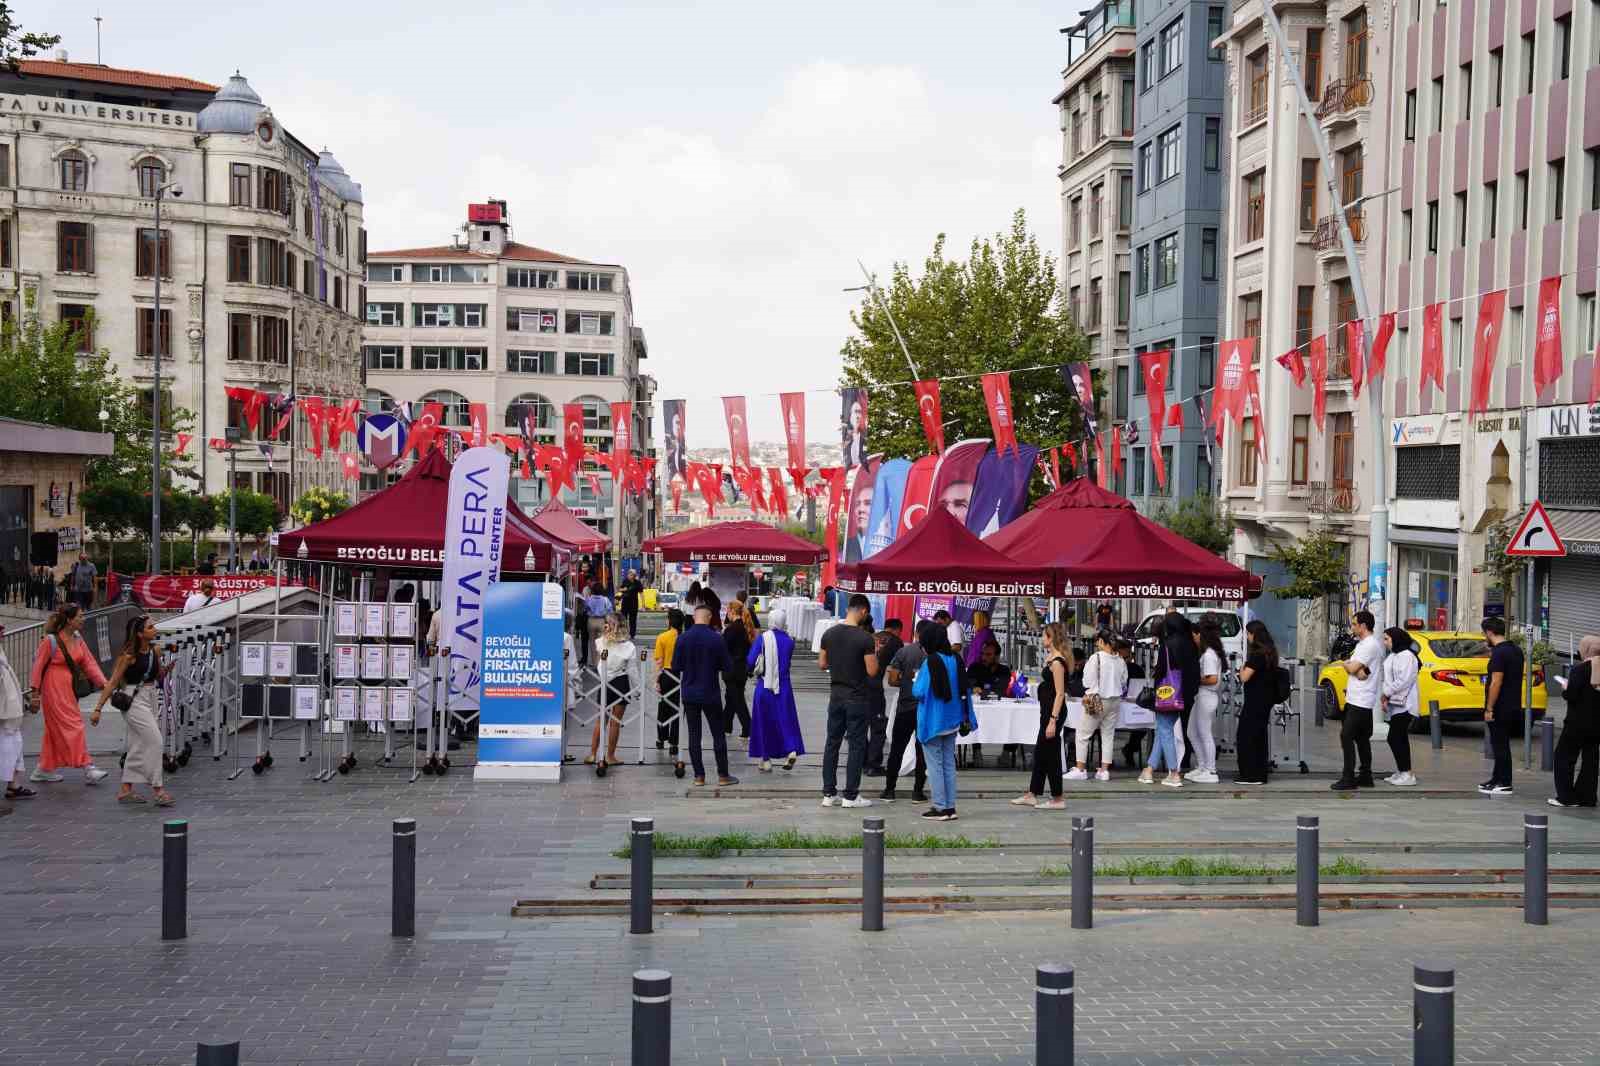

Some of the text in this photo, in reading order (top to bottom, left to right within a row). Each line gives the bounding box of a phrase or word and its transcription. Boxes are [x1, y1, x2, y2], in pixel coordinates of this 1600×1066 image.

[460, 467, 490, 557] PERA
[489, 507, 503, 562] CENTER
[337, 545, 406, 560] BEYOĞLU
[896, 581, 916, 592] T.C.
[918, 580, 974, 594] BEYOĞLU
[976, 581, 1045, 595] BELEDİYESİ
[1095, 585, 1116, 596] T.C.
[1118, 583, 1173, 597] BEYOĞLU
[1176, 585, 1244, 599] BELEDİYESİ
[485, 634, 531, 647] BEYOĞLU
[485, 647, 531, 659] KARİYER
[484, 659, 552, 671] FIRSATLARI
[484, 672, 552, 687] BULUŞMASI
